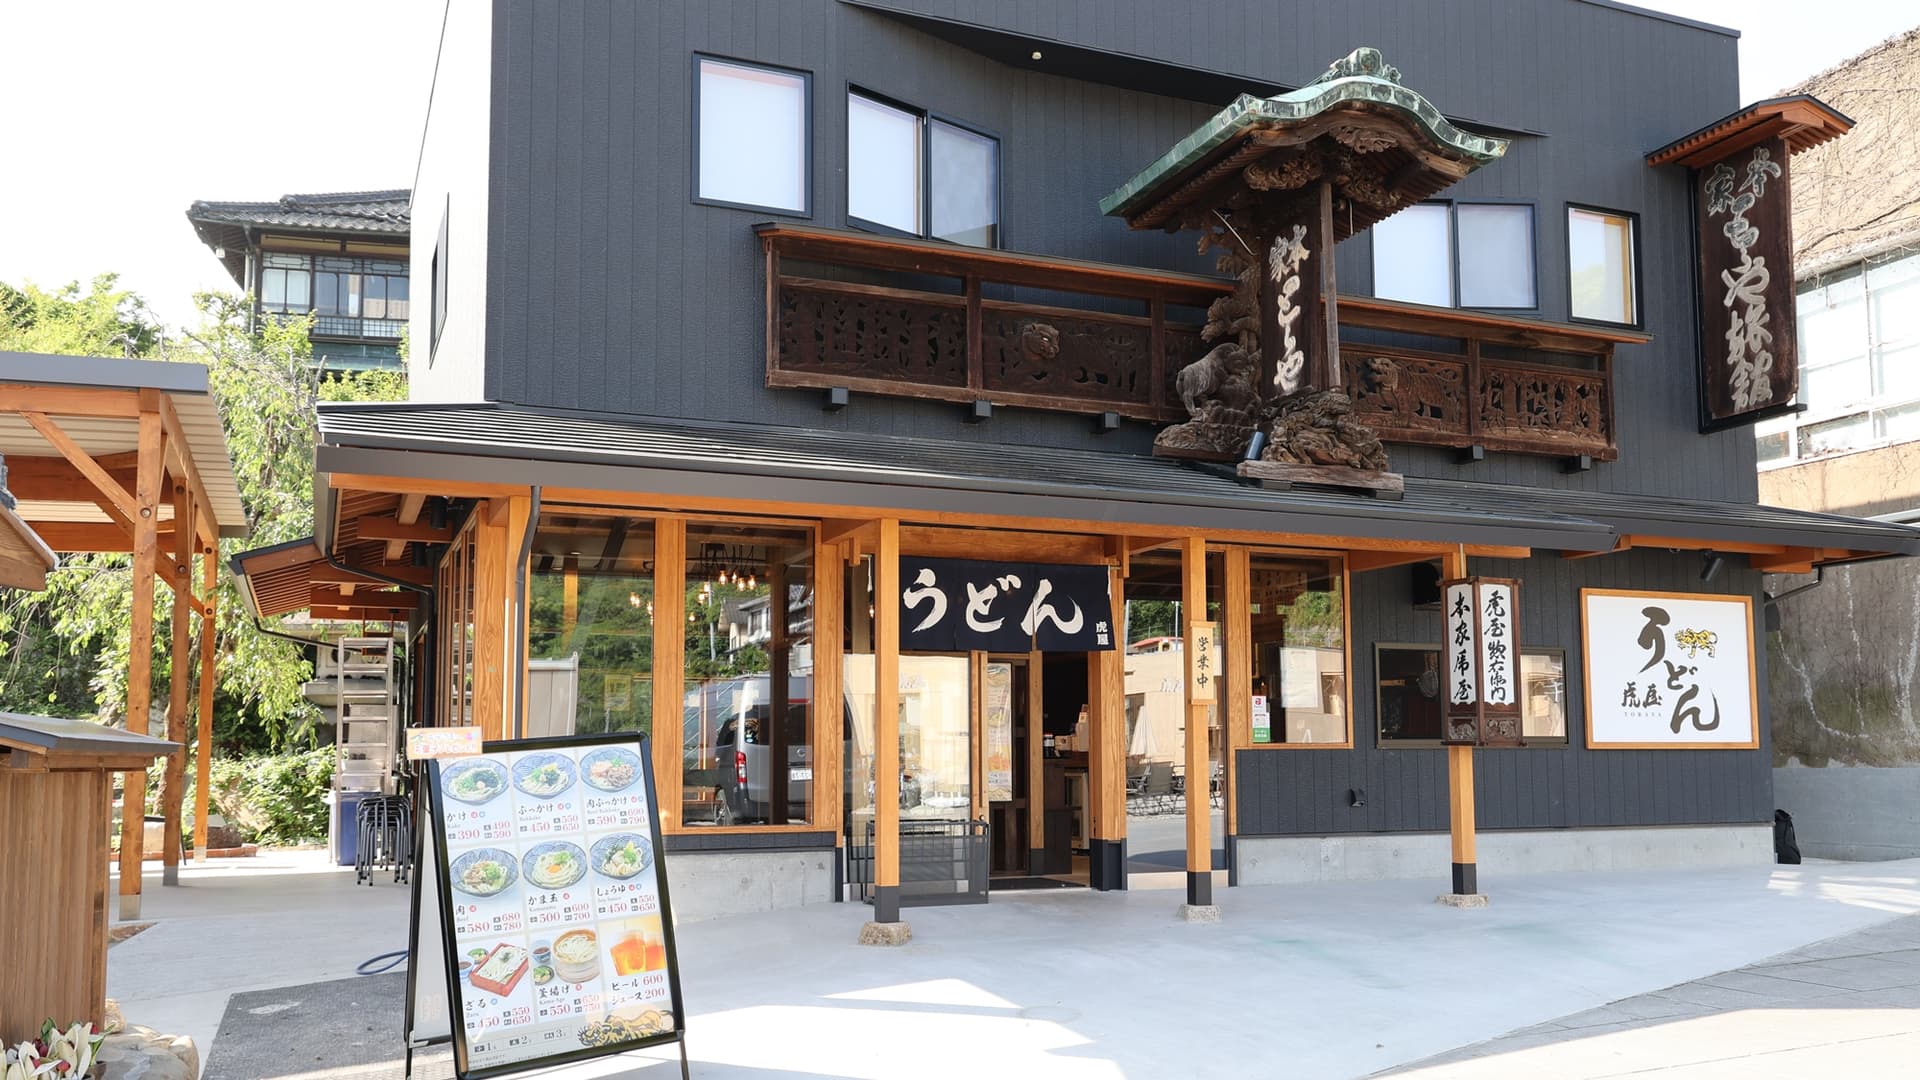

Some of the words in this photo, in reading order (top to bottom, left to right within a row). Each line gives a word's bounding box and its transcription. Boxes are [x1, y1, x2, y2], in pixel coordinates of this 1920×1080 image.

[903, 568, 1084, 636] うどん
[1197, 636, 1209, 688] 営業中
[1637, 606, 1720, 734] うどん
[1621, 681, 1662, 708] 虎屋
[447, 811, 466, 821] かけ
[561, 815, 578, 824] 550
[596, 816, 616, 825] 590
[628, 816, 645, 825] 790
[458, 829, 480, 840] 390
[493, 830, 511, 838] 590
[597, 884, 626, 897] しょうゆ
[528, 893, 558, 905] かま玉
[638, 895, 655, 904] 550
[571, 903, 589, 913] 600
[607, 903, 627, 913] 450
[639, 903, 656, 912] 650
[502, 912, 520, 921] 680
[539, 912, 560, 923] 500
[573, 912, 590, 921] 700
[467, 922, 489, 933] 580
[503, 922, 521, 931] 780
[643, 975, 663, 985] 600
[645, 987, 665, 999] 200
[465, 998, 486, 1011] ざる
[512, 1007, 530, 1016] 550
[550, 1004, 571, 1016] 550
[478, 1016, 499, 1029] 450
[513, 1015, 531, 1025] 650
